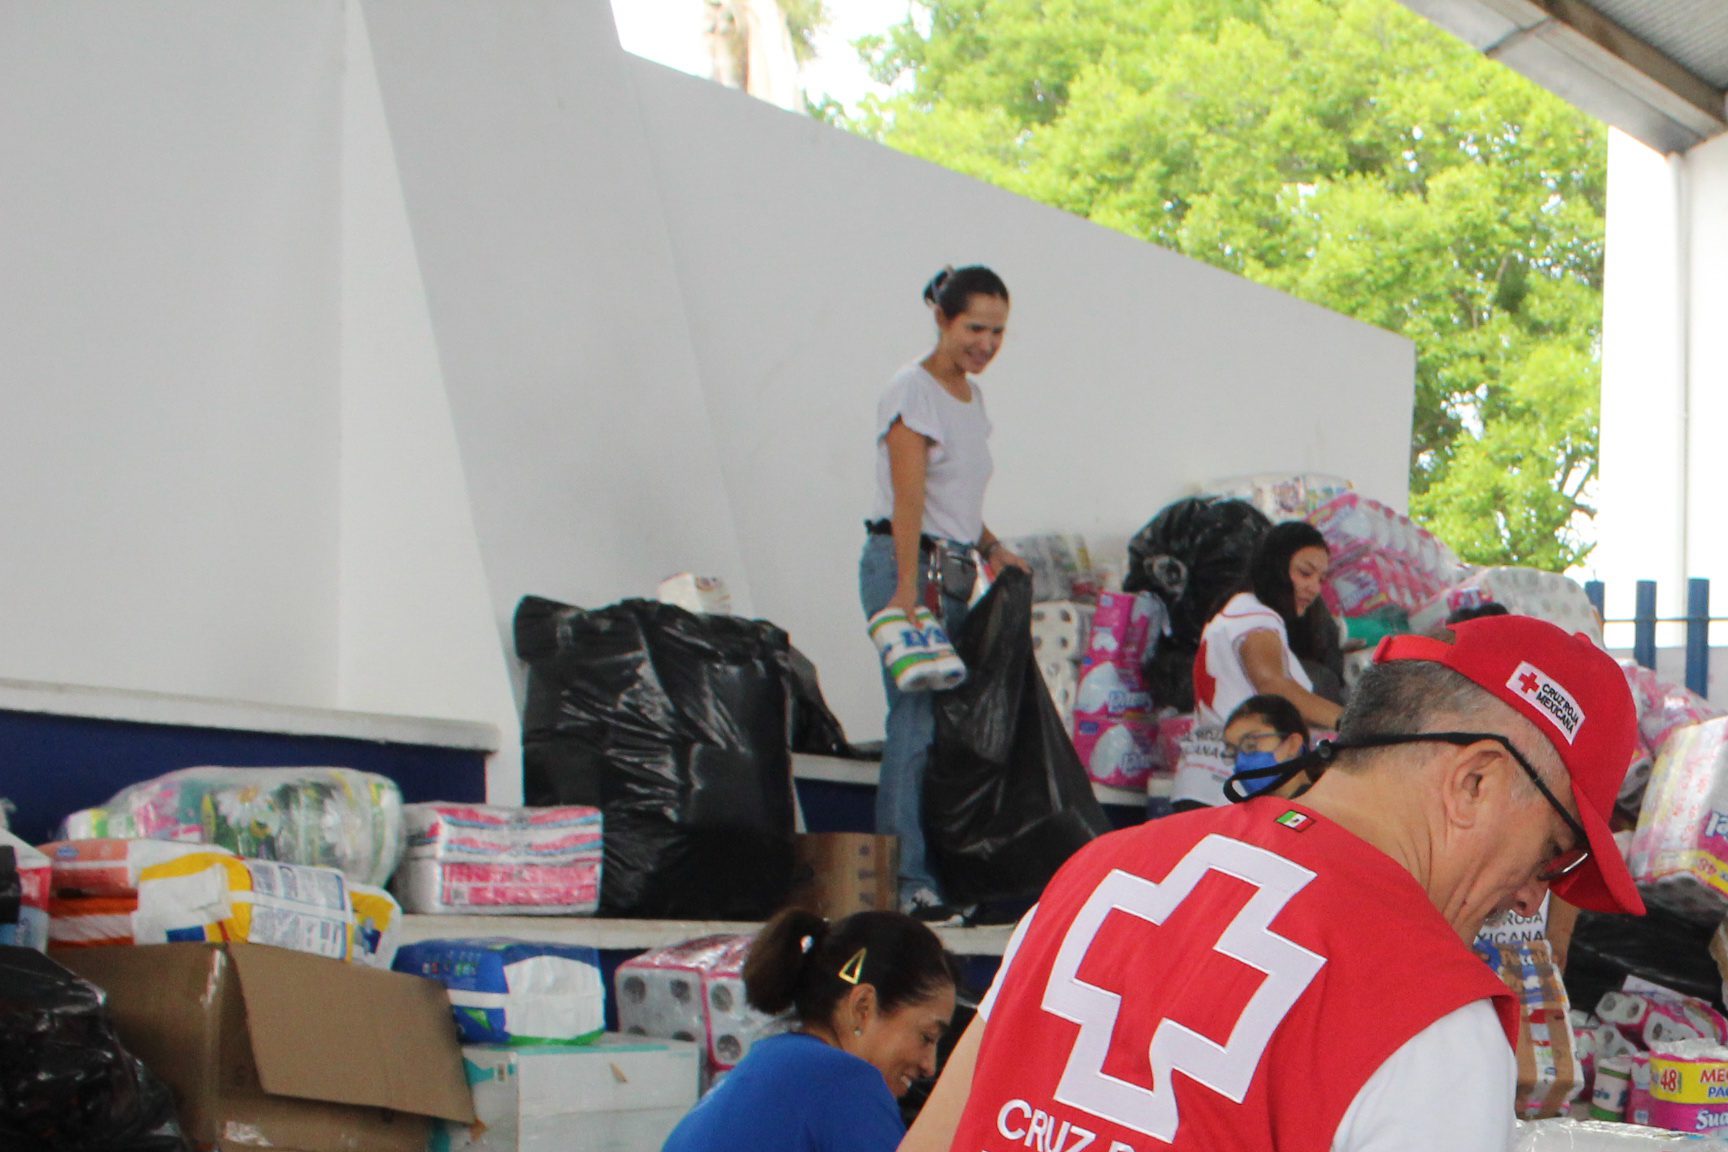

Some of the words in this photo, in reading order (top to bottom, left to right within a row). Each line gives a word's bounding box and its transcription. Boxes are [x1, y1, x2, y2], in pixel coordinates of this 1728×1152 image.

[1536, 692, 1574, 733] MEXICANA
[1542, 683, 1566, 706] CRUZ
[1563, 702, 1579, 725] ROJA
[1660, 1069, 1679, 1092] 48
